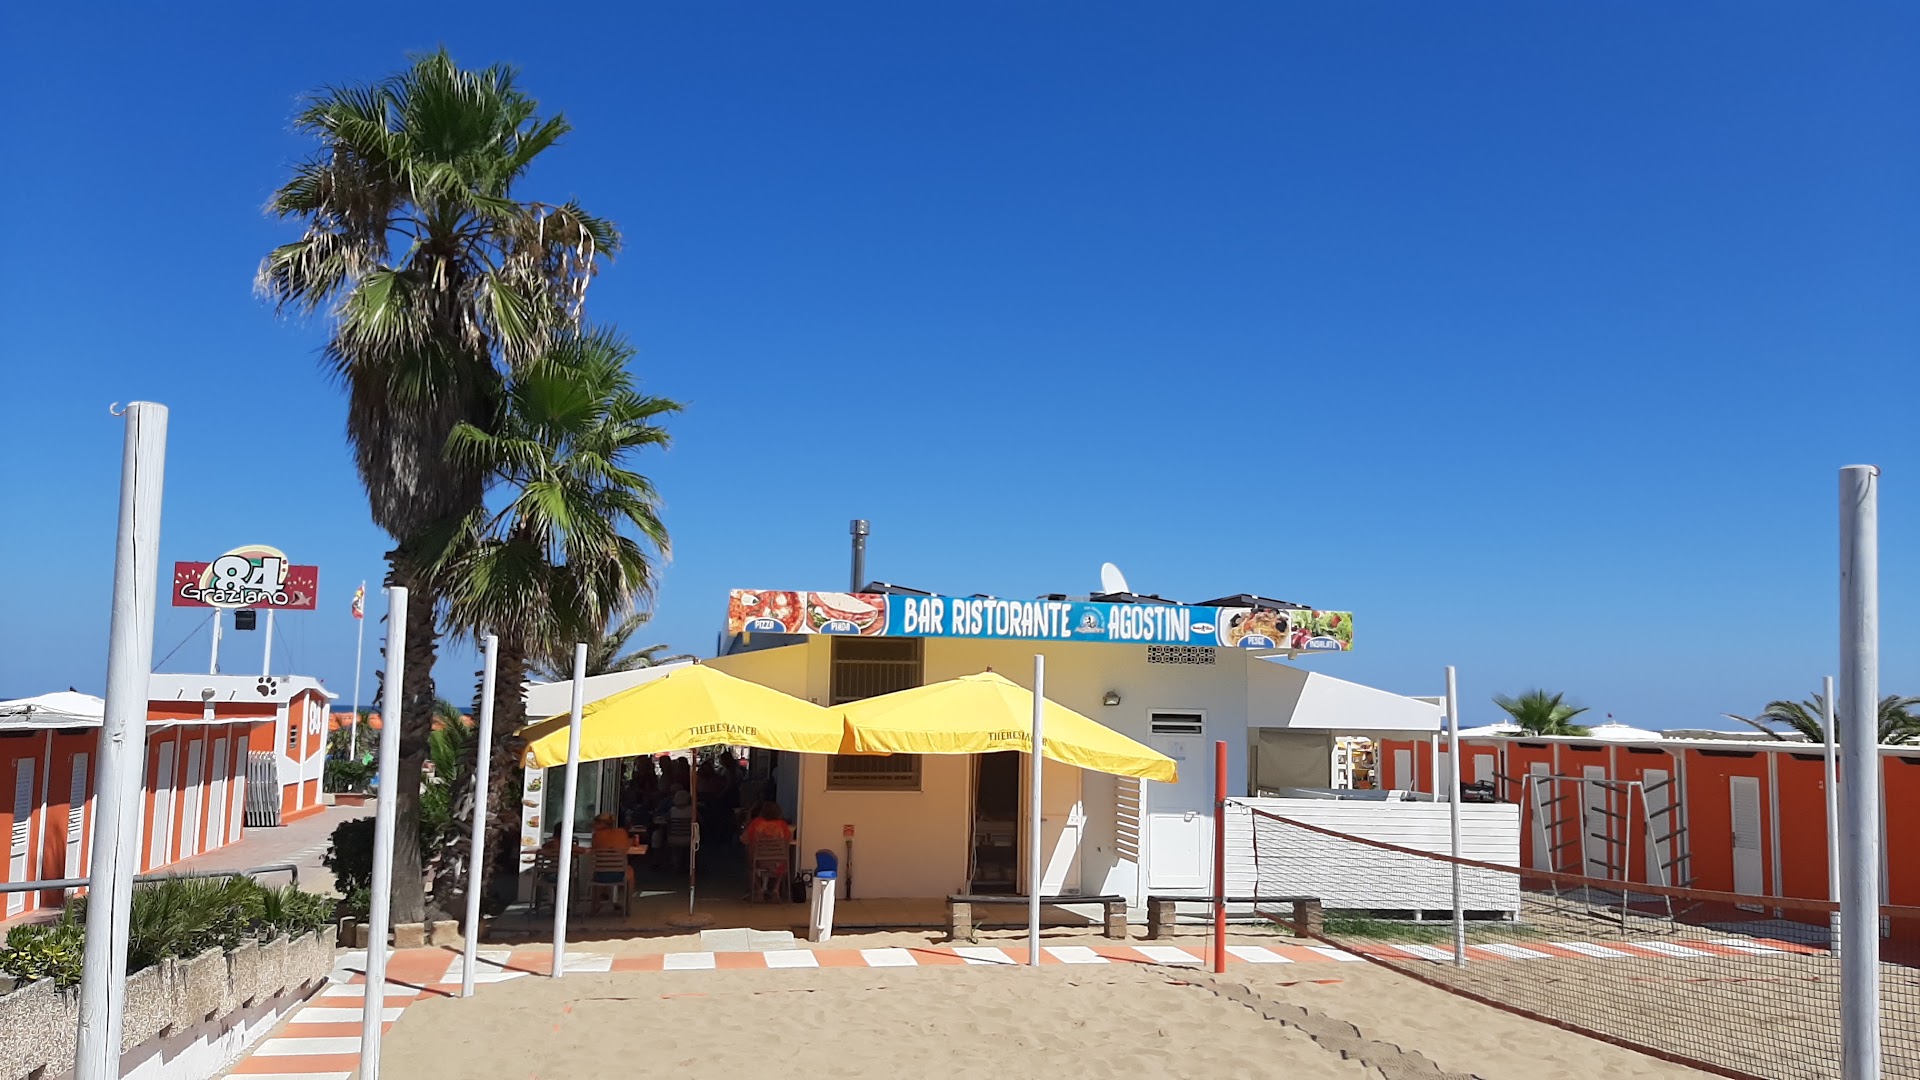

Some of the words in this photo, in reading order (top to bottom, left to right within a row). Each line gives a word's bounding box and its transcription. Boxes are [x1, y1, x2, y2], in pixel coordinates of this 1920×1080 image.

[213, 555, 284, 594] 84
[180, 583, 289, 606] Graziano
[754, 620, 775, 630] PIZZA
[904, 597, 944, 634] BAR
[951, 598, 1071, 638] RISTORANTE
[1107, 604, 1191, 642] AGOSTINI
[689, 723, 757, 736] THERESIANER
[988, 730, 1047, 746] THERESIAR
